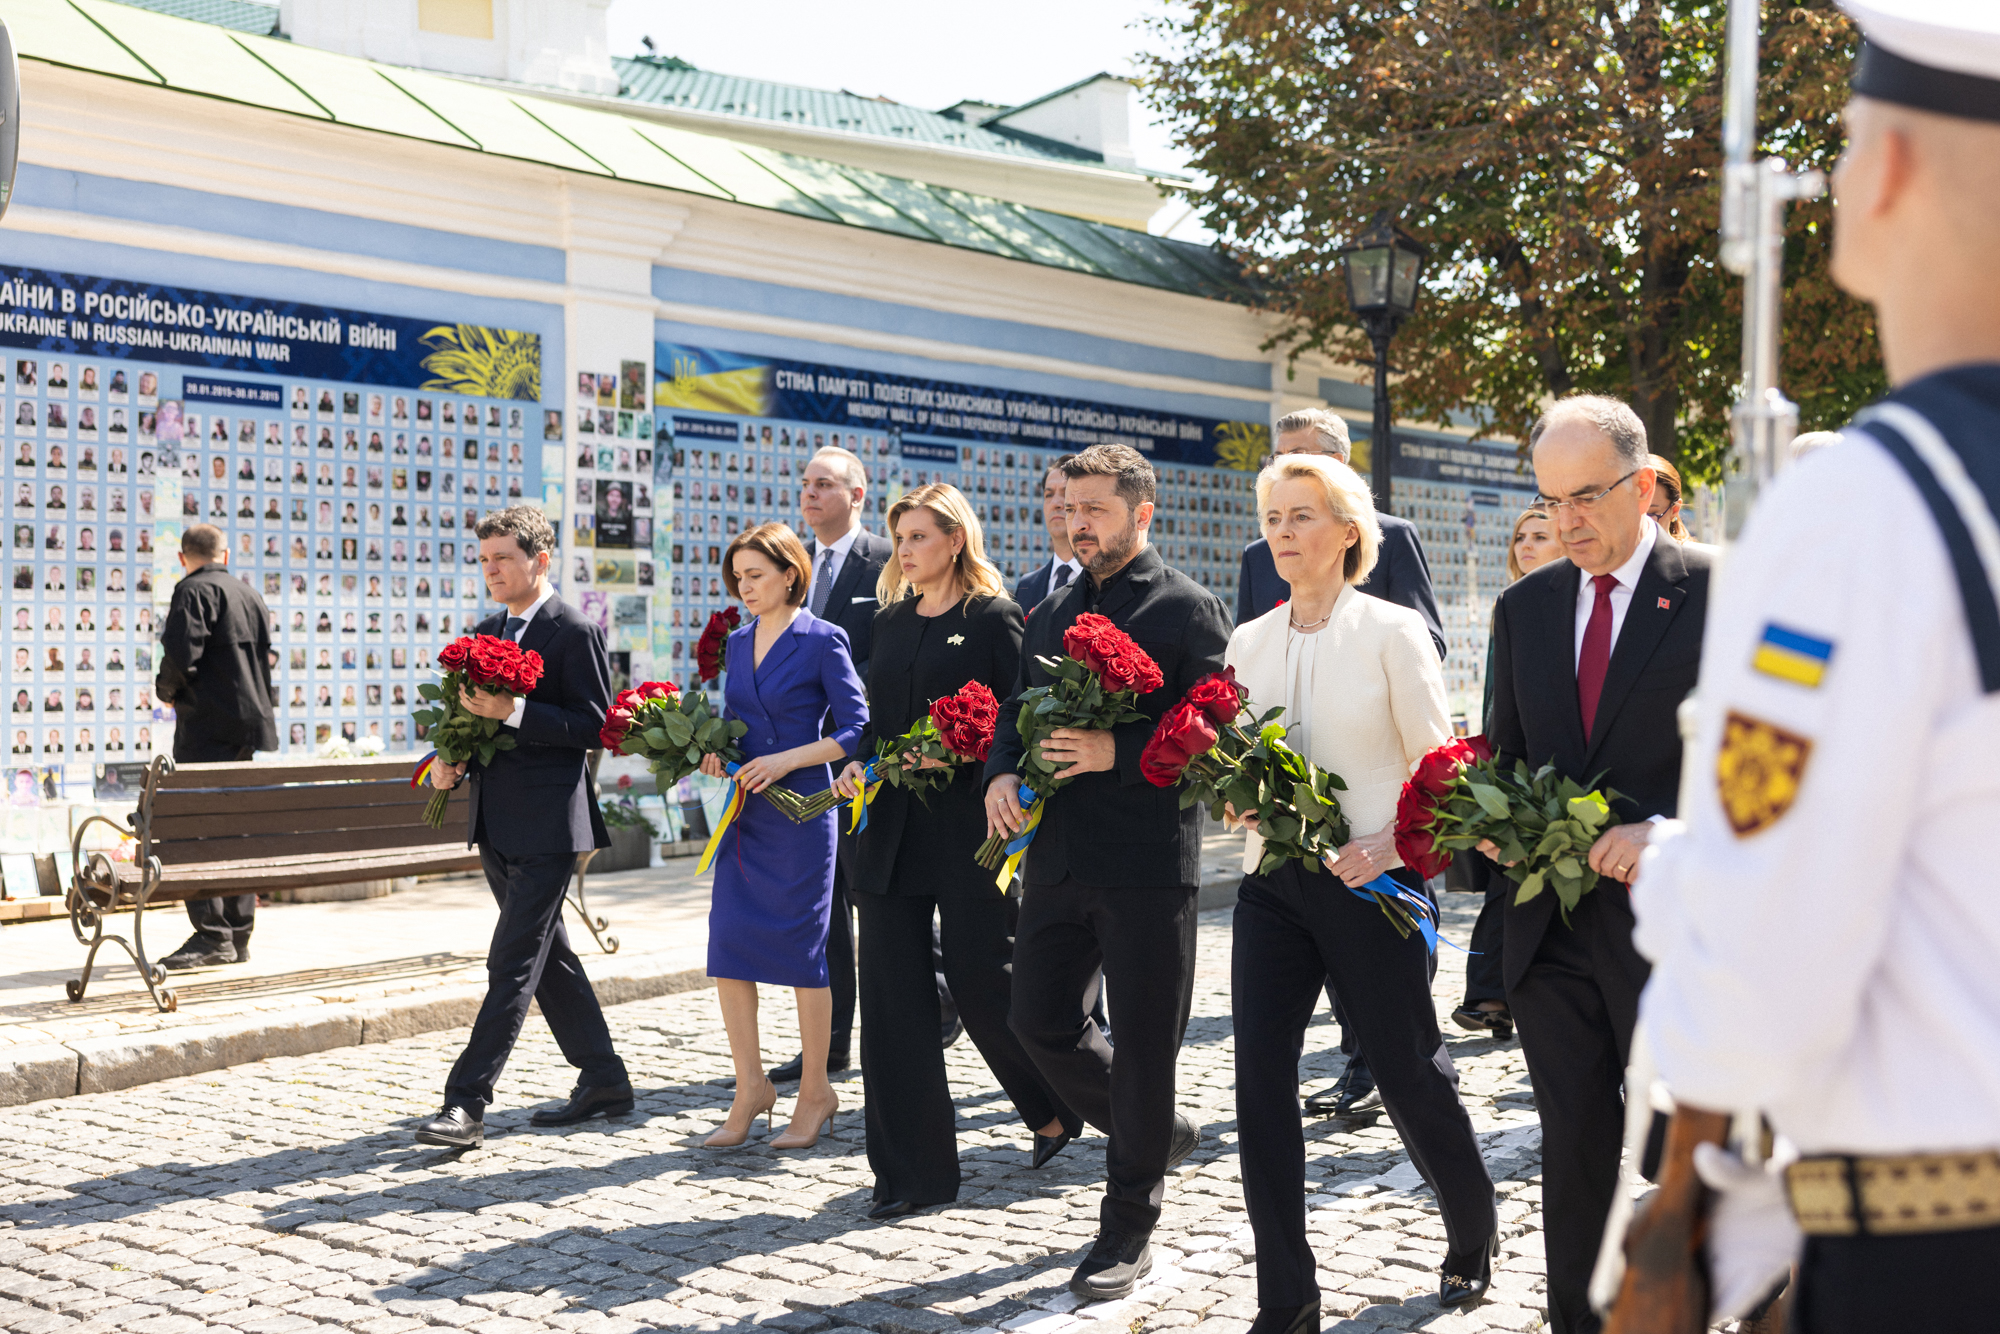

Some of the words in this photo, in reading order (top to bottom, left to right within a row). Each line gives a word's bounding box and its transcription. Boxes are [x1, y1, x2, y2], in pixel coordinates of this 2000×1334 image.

[0, 312, 67, 338] KRAINE
[71, 320, 88, 340] IN
[93, 322, 252, 358] RUSSIAN-UKRAINIAN
[255, 341, 290, 362] WAR
[61, 288, 76, 313] В
[84, 291, 342, 345] РОСІЙСЬКО-УКРАЇНСЬКІЙ
[348, 321, 397, 351] ВІЙНІ
[775, 369, 815, 393] СТІНА
[890, 406, 915, 423] WALL
